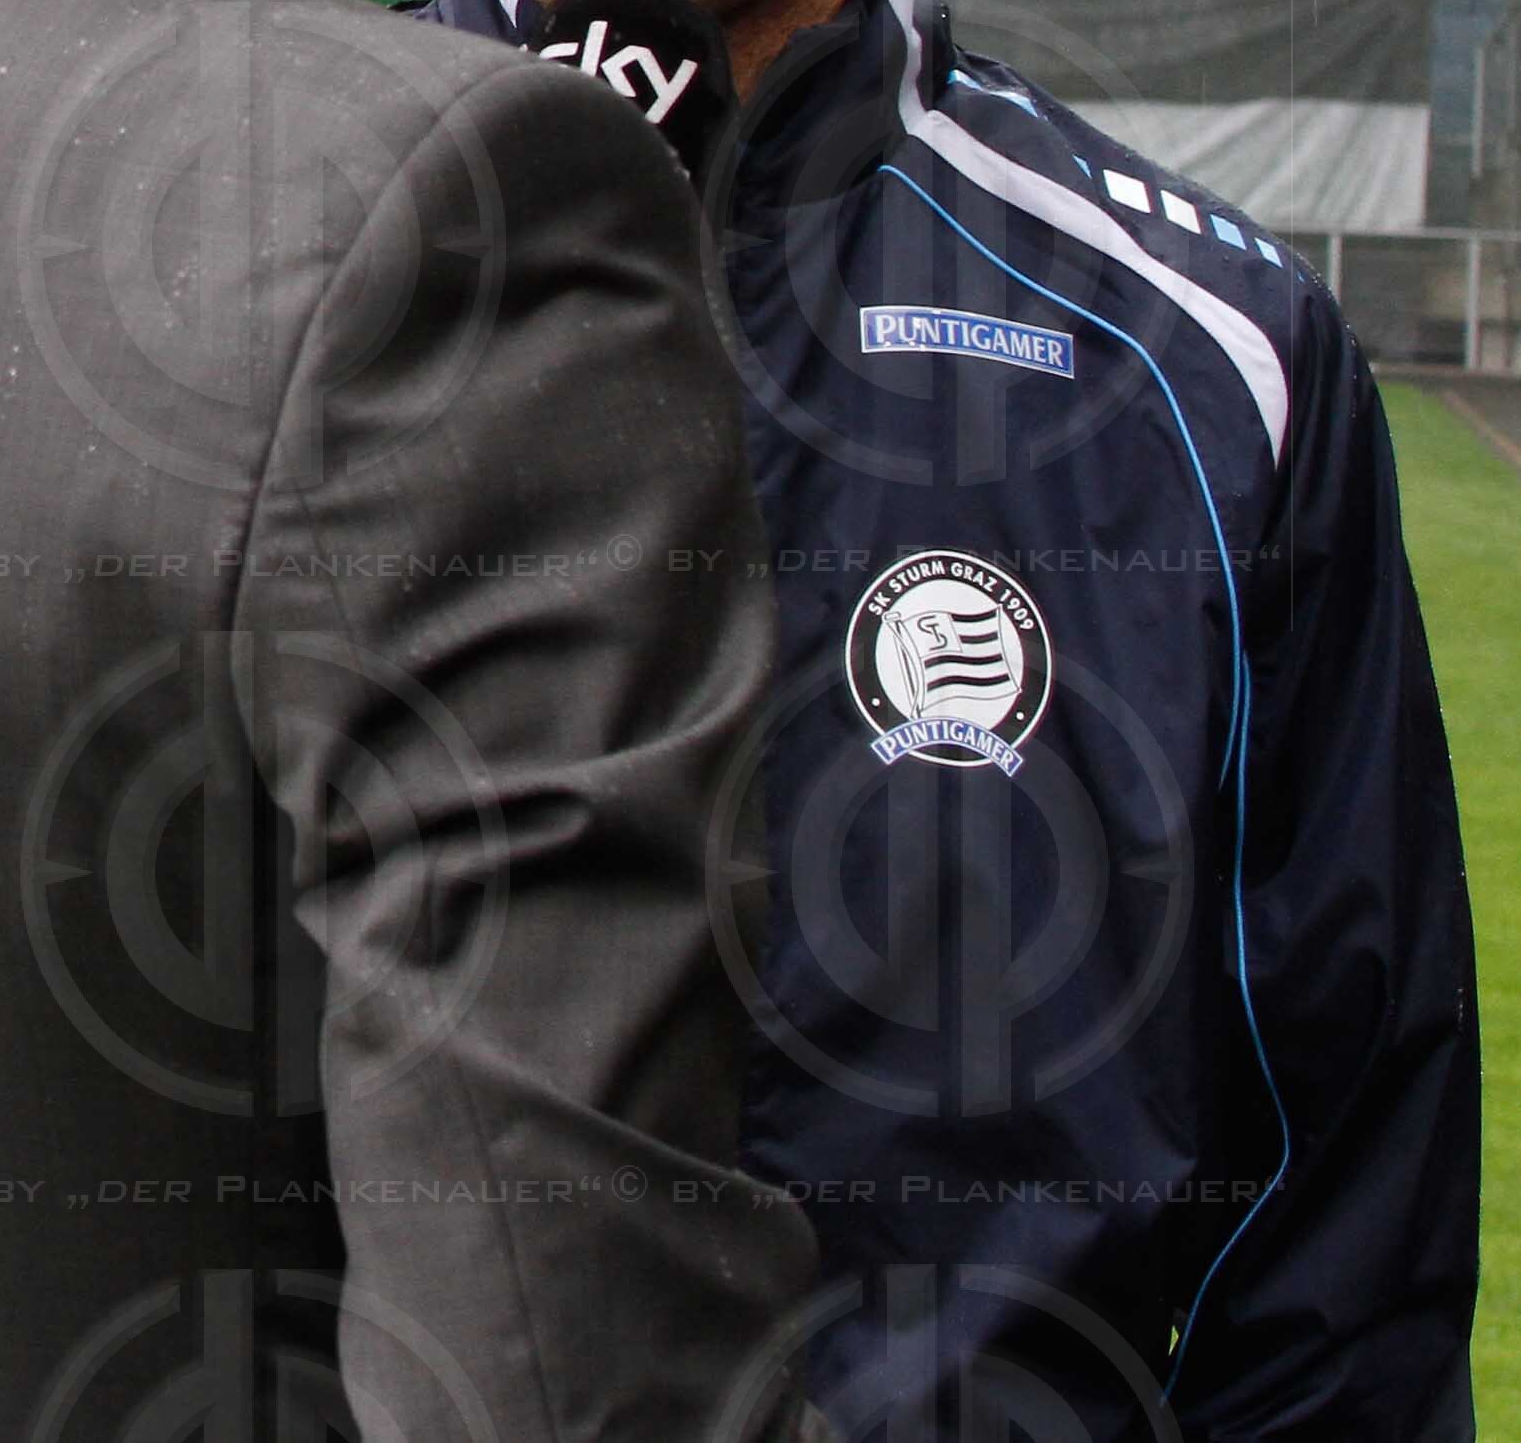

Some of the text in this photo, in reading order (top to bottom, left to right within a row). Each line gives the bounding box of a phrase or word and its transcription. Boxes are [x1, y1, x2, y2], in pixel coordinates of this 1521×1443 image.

[874, 314, 1064, 368] PUNTIGAMER
[868, 560, 1036, 631] SK STURM GRAZ 1909
[879, 719, 1015, 771] PUNTIGAMER
